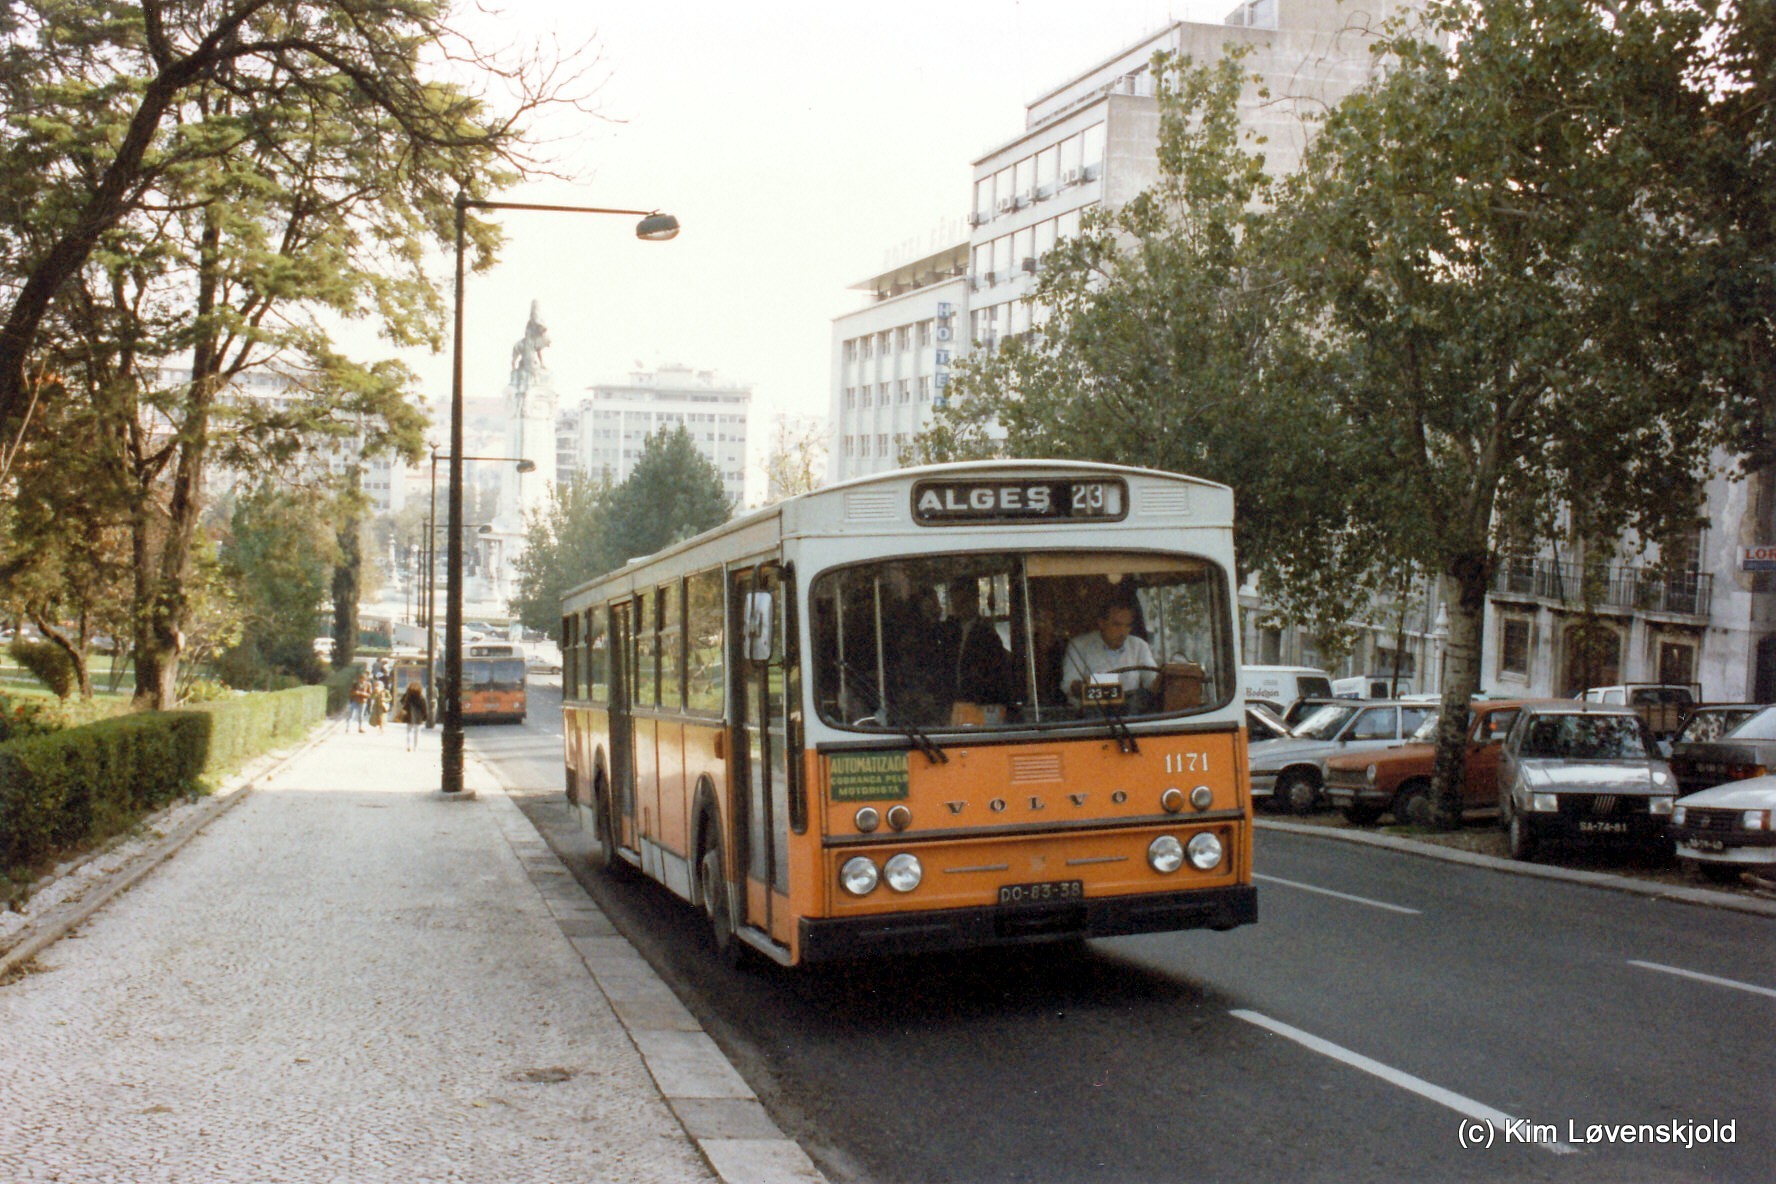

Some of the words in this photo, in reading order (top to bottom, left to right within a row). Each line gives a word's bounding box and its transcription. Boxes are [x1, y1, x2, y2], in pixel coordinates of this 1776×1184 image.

[918, 486, 1050, 511] ALGES
[1072, 484, 1102, 508] 23
[831, 756, 908, 773] AUTOMATIZADA
[1166, 752, 1208, 773] 1171
[839, 785, 899, 795] MOTORISTA
[945, 791, 1127, 814] VOLVO
